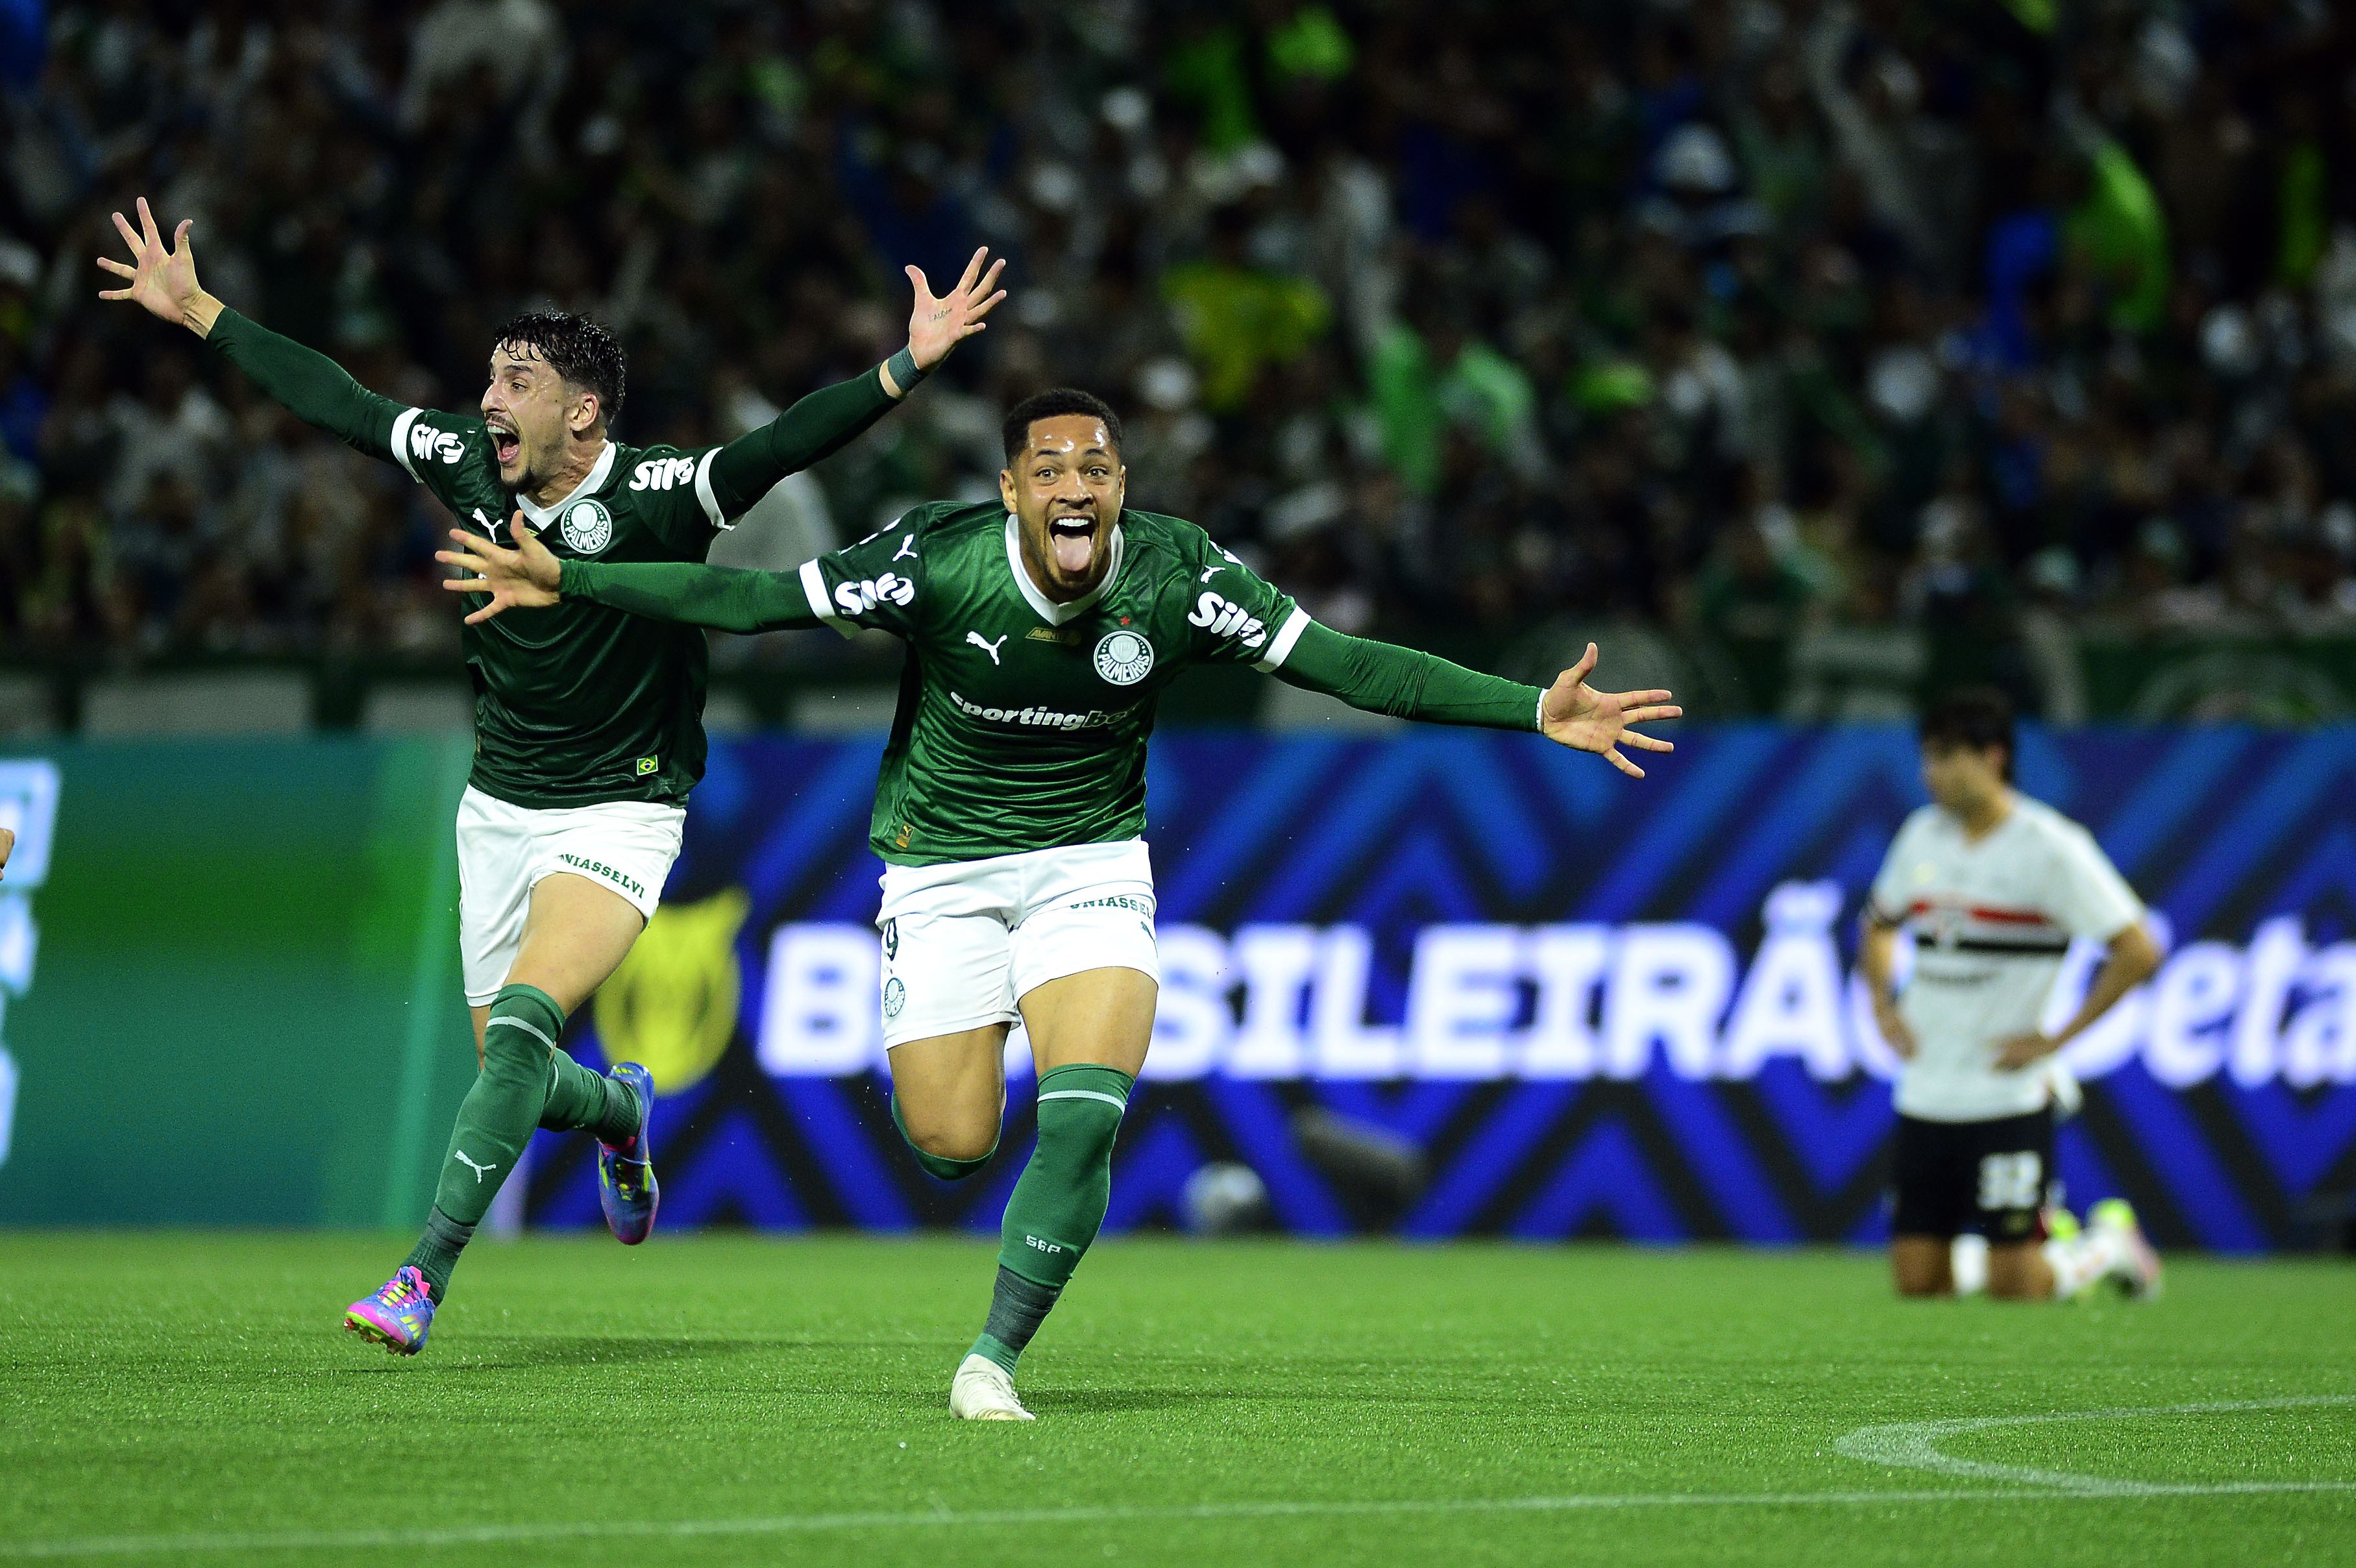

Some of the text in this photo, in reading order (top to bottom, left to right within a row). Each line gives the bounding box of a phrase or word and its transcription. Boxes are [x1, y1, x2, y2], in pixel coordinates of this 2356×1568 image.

[564, 521, 608, 551] PALMEIRAS
[1098, 653, 1150, 682] PALMEIRAS
[950, 691, 1140, 731] sportingbe
[558, 853, 645, 900] NIASSELVI
[757, 879, 1915, 1080] BSILEIRÃ
